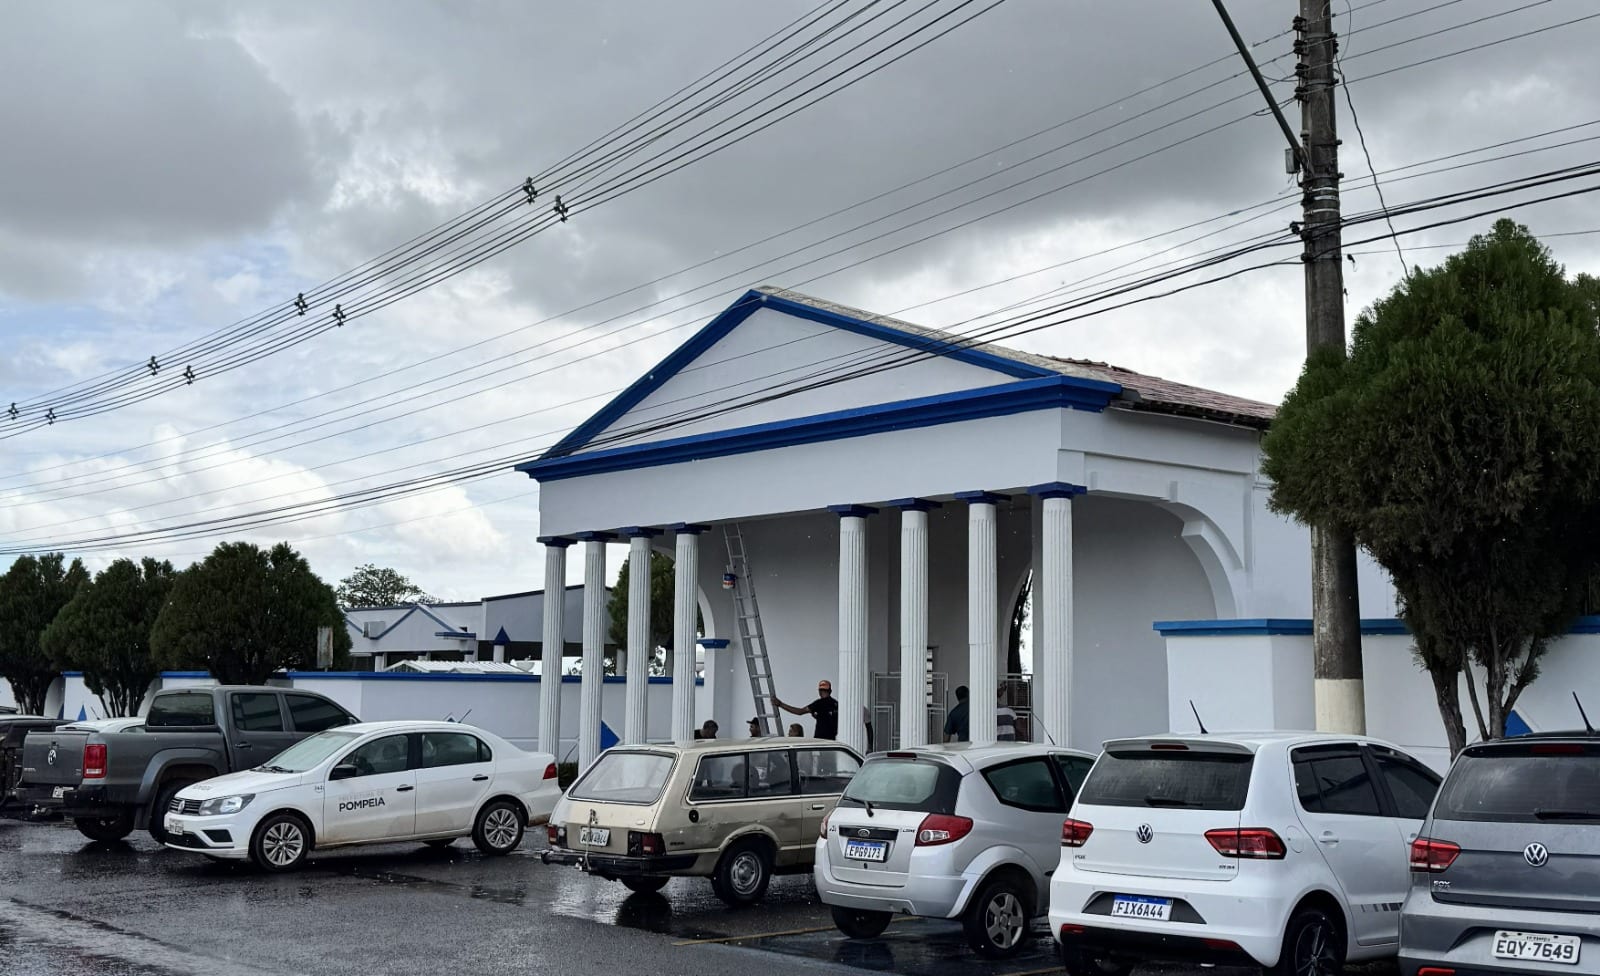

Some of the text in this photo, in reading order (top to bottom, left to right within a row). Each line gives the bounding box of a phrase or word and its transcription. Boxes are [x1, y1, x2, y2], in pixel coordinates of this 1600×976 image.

[339, 797, 386, 812] POMPEIA
[849, 845, 881, 858] EPG9173
[1116, 901, 1163, 918] FIX6A44
